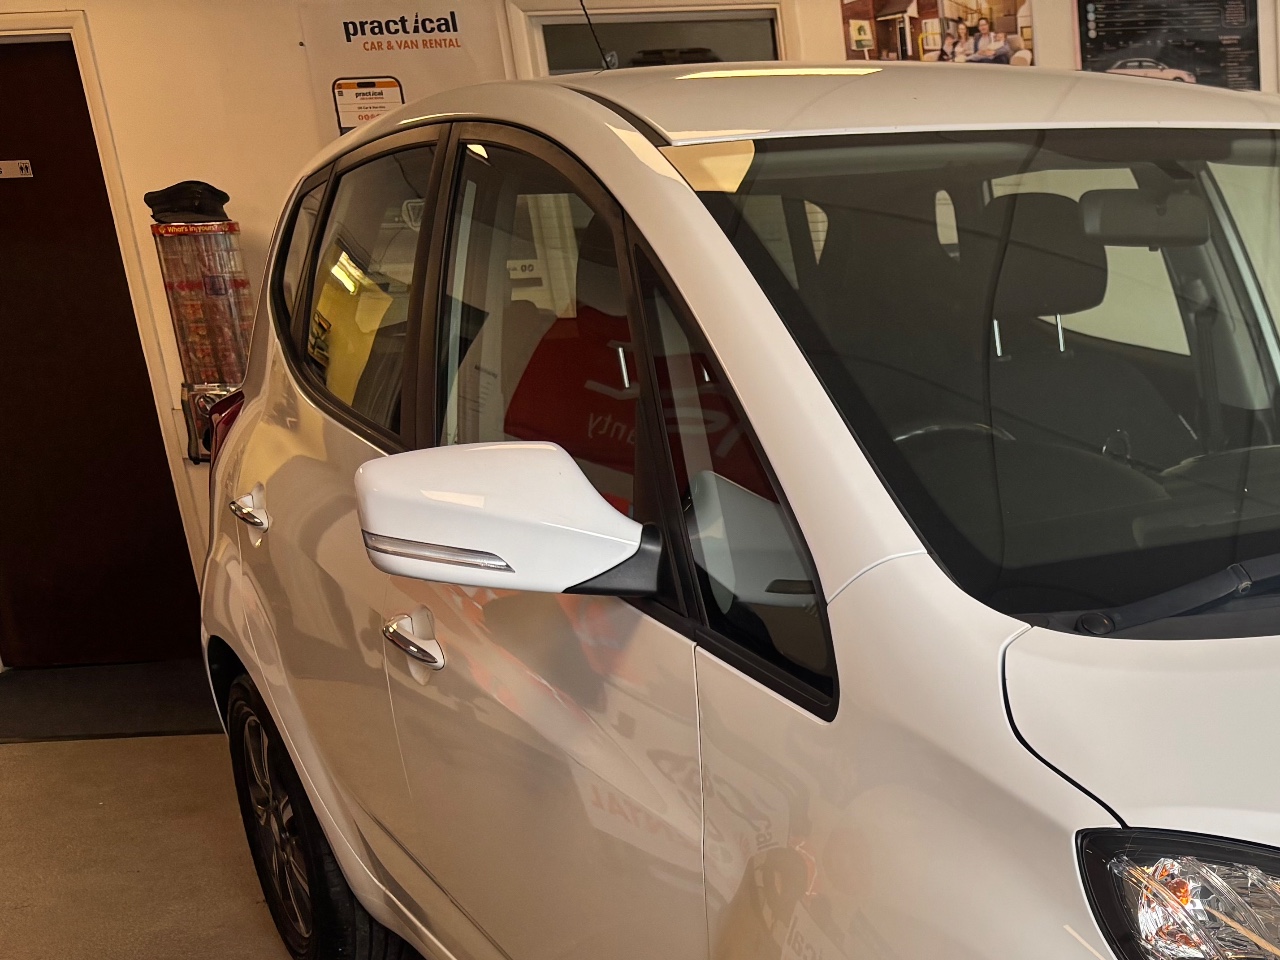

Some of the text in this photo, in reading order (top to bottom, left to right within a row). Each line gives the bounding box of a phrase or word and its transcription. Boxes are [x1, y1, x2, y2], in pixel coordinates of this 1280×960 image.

[343, 11, 458, 42] practical
[363, 38, 461, 51] CAR & VAN RENTAL
[355, 90, 384, 98] practical
